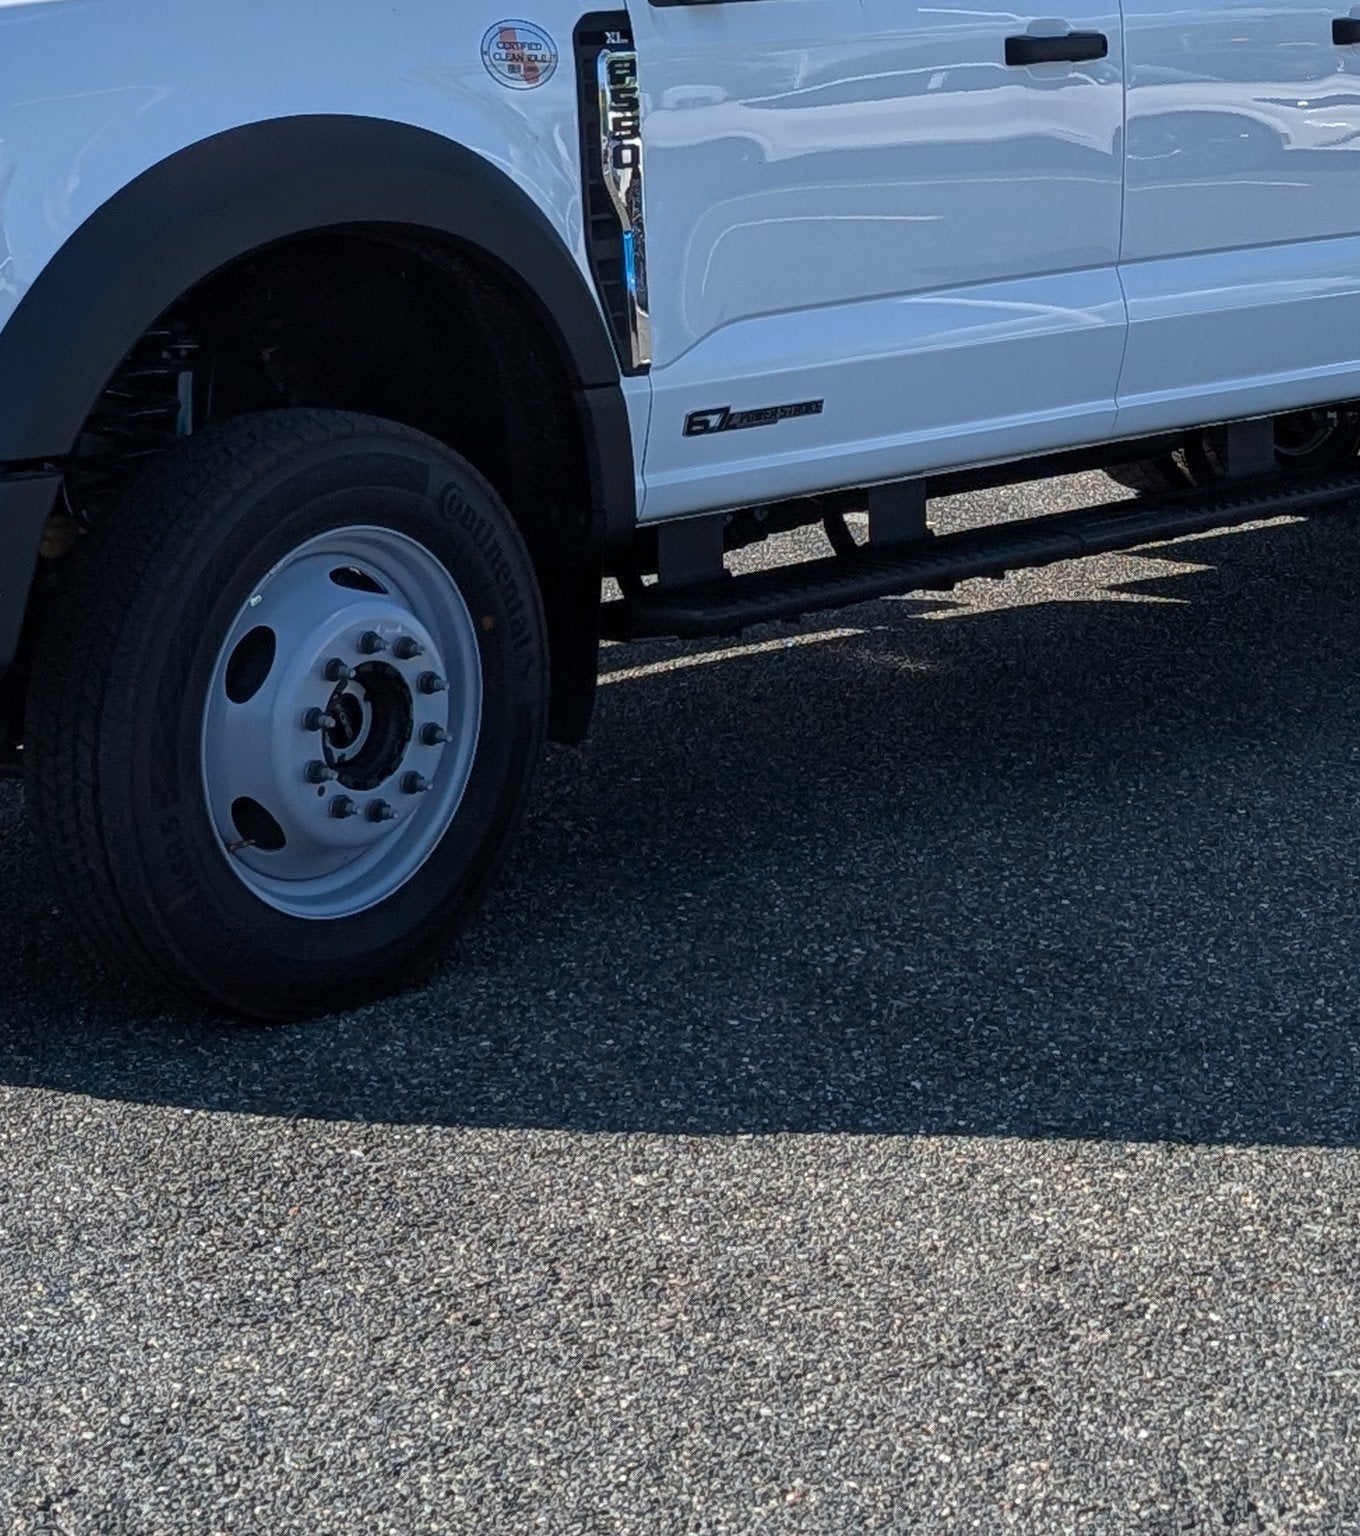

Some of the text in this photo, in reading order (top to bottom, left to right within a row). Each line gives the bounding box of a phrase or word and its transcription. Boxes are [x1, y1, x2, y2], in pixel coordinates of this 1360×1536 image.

[603, 30, 630, 45] XL
[496, 41, 543, 51] CERTIFIED
[492, 52, 524, 63] CLEAN
